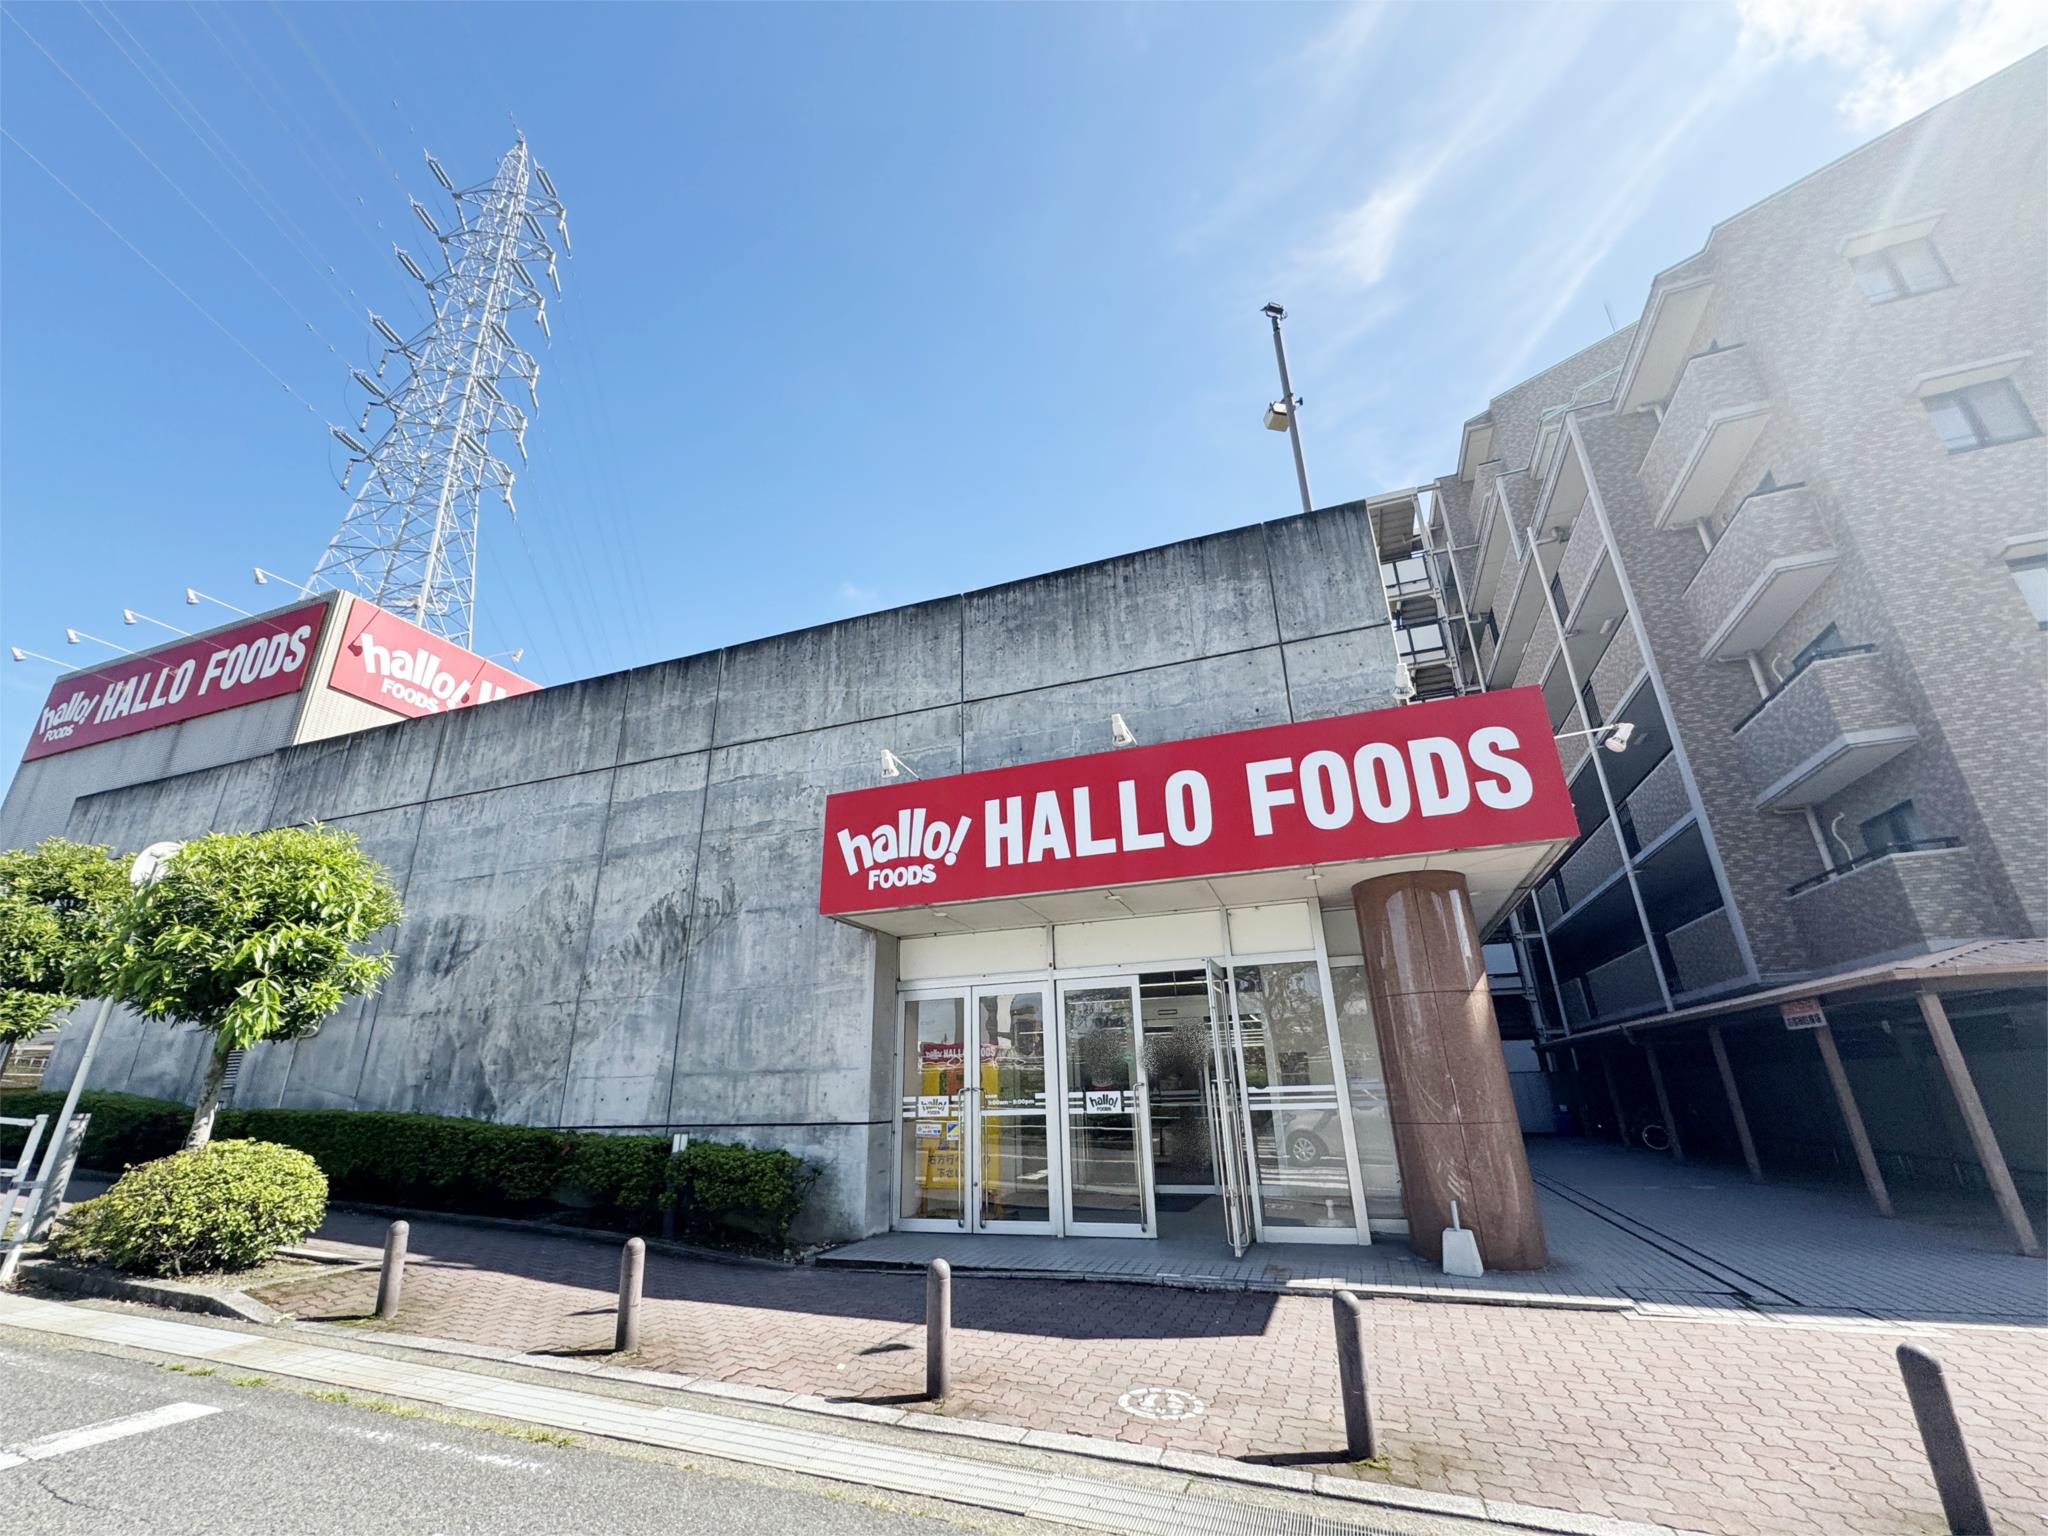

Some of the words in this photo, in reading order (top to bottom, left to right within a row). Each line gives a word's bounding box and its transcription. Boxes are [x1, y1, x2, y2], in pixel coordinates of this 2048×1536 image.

[94, 658, 196, 725] HALLO
[198, 625, 312, 696] FOODS
[361, 632, 471, 711] hallo!
[39, 691, 100, 734] hallo!
[381, 677, 440, 713] FOODS
[43, 724, 75, 743] FOODS
[984, 770, 1213, 868] HALLO
[1245, 726, 1534, 837] FOODS
[836, 807, 973, 876] hallo!
[867, 863, 937, 891] FOODS
[1089, 1094, 1118, 1108] hallo!
